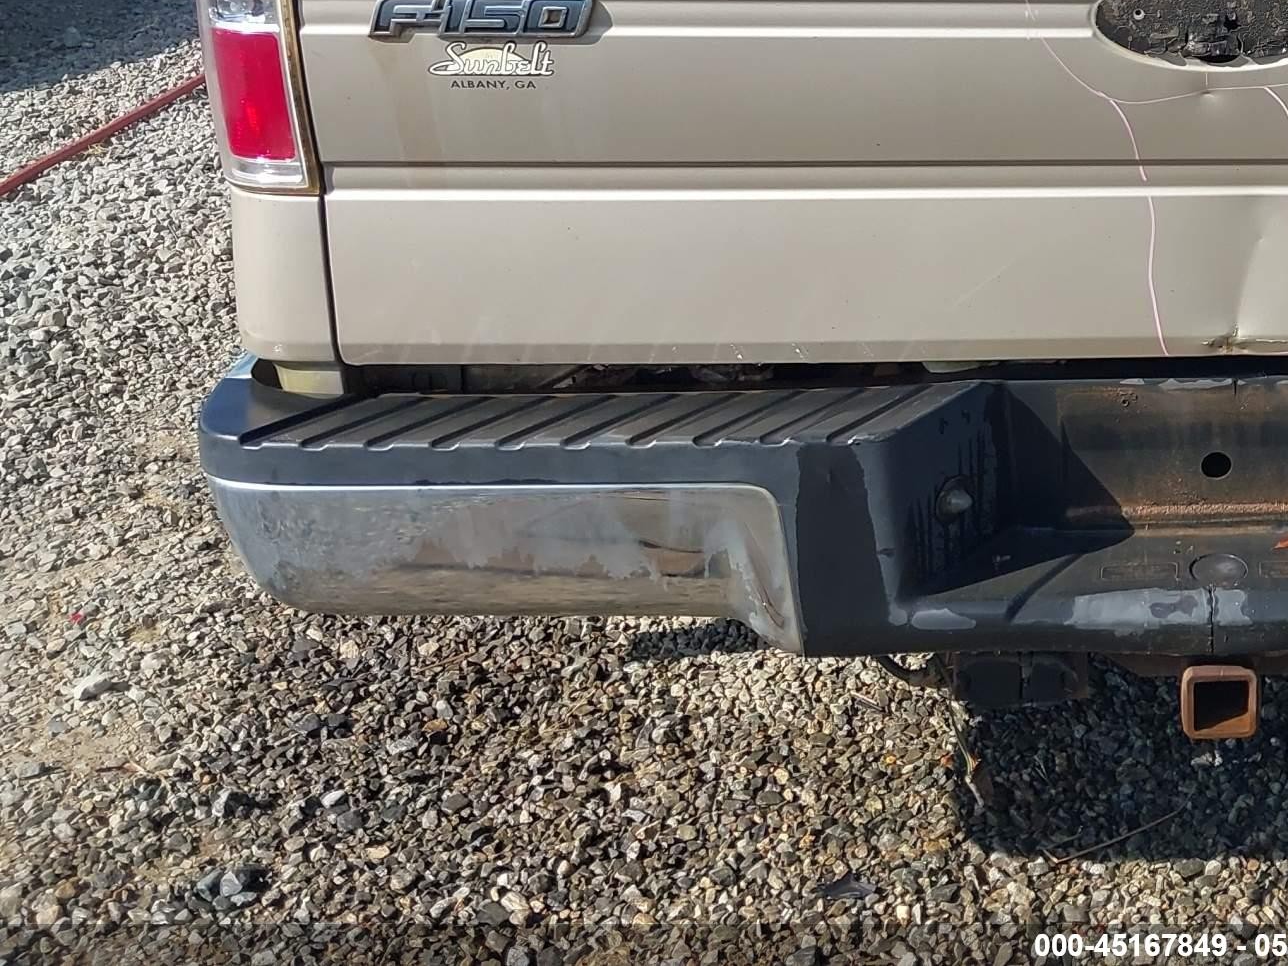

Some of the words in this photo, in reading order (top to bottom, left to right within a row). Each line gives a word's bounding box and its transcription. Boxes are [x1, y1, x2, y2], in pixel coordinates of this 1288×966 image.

[428, 41, 555, 77] Sunbelt
[451, 80, 510, 91] ALBANY,
[515, 80, 536, 90] GA
